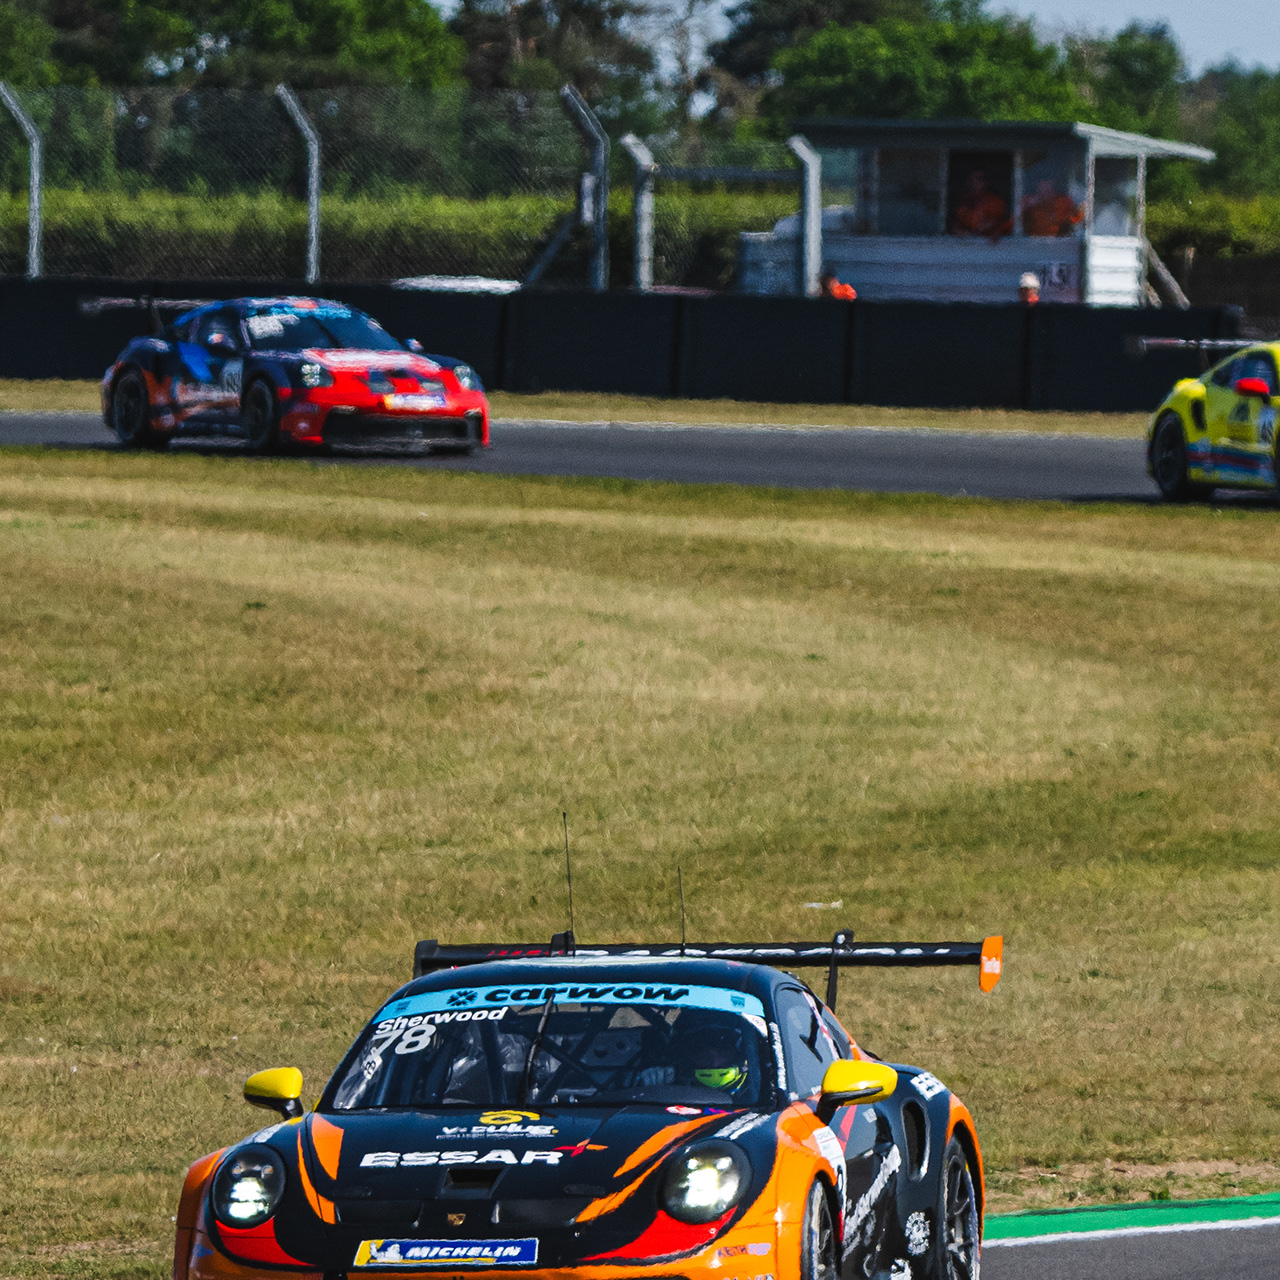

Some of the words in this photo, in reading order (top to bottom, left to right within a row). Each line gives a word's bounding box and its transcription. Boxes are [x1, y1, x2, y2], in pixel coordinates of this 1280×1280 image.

[484, 985, 689, 1003] carwow
[375, 1007, 509, 1034] Sherwood
[372, 1024, 437, 1056] 78
[359, 1149, 563, 1168] ESSAR
[405, 1246, 522, 1258] MICHELIN
